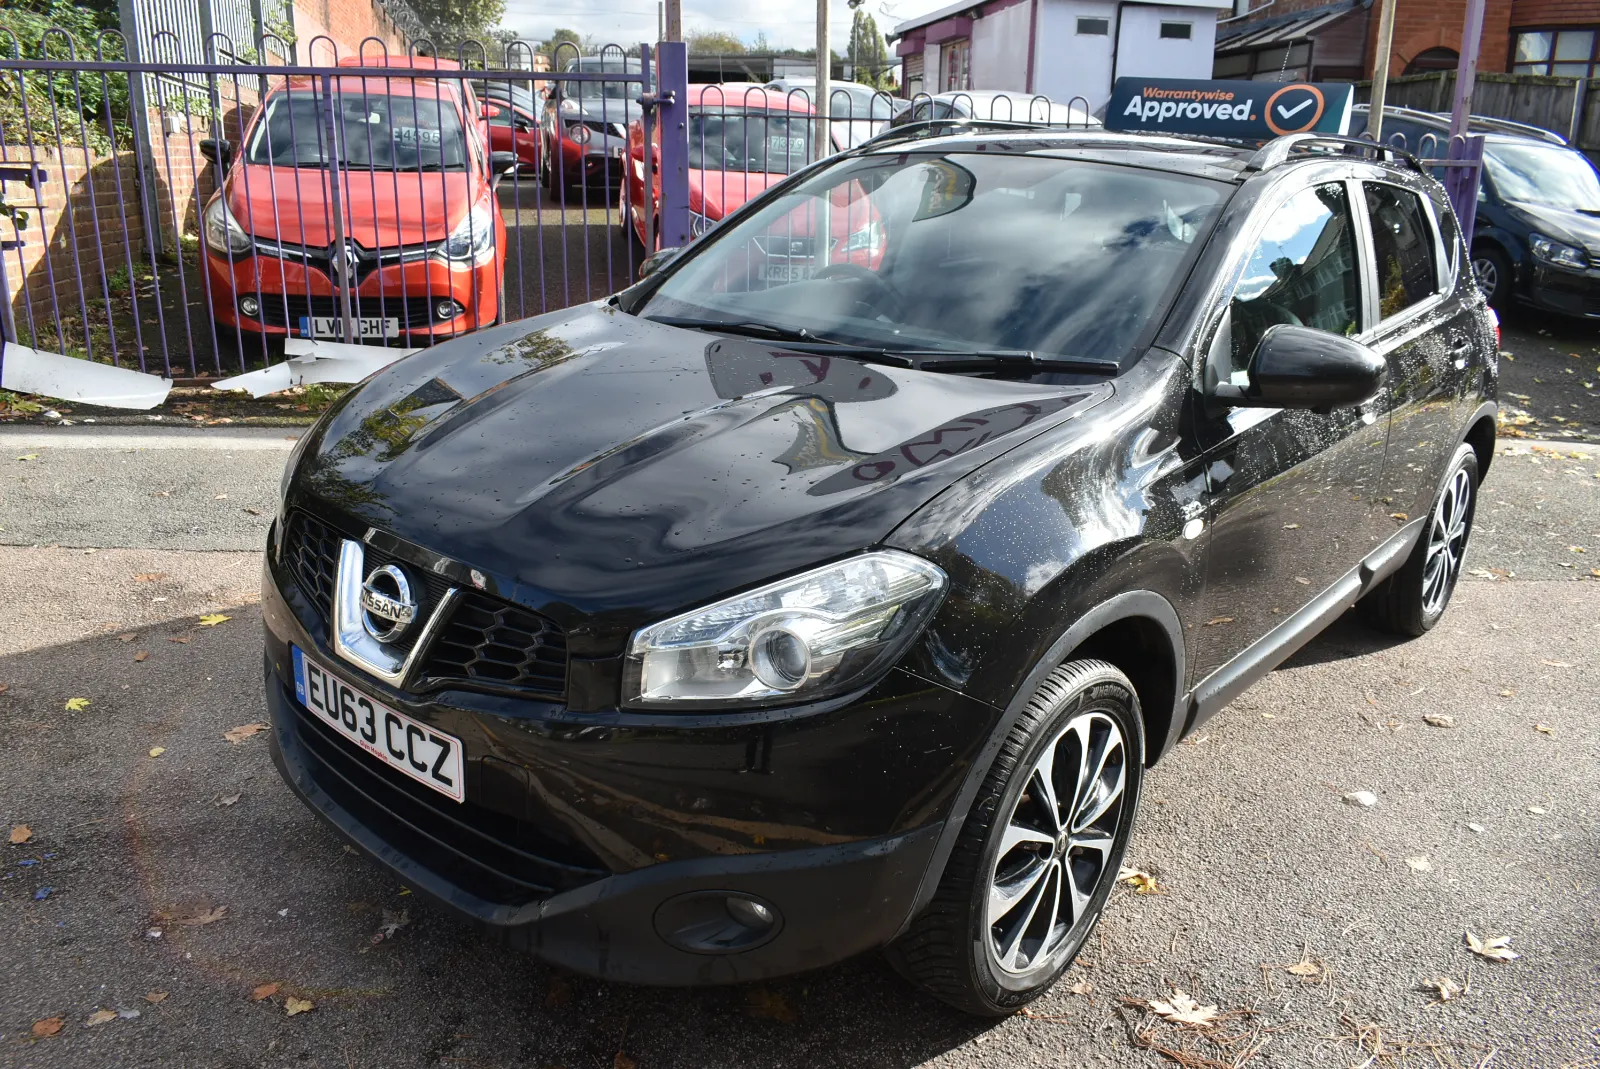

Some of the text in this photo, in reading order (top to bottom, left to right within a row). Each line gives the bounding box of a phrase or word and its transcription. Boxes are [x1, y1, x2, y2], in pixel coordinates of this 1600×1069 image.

[1143, 87, 1235, 102] Warrantywise
[1123, 95, 1257, 123] Approved.
[314, 319, 352, 334] LV1
[362, 587, 401, 618] NISSAN
[308, 661, 453, 788] EU63 CCZ
